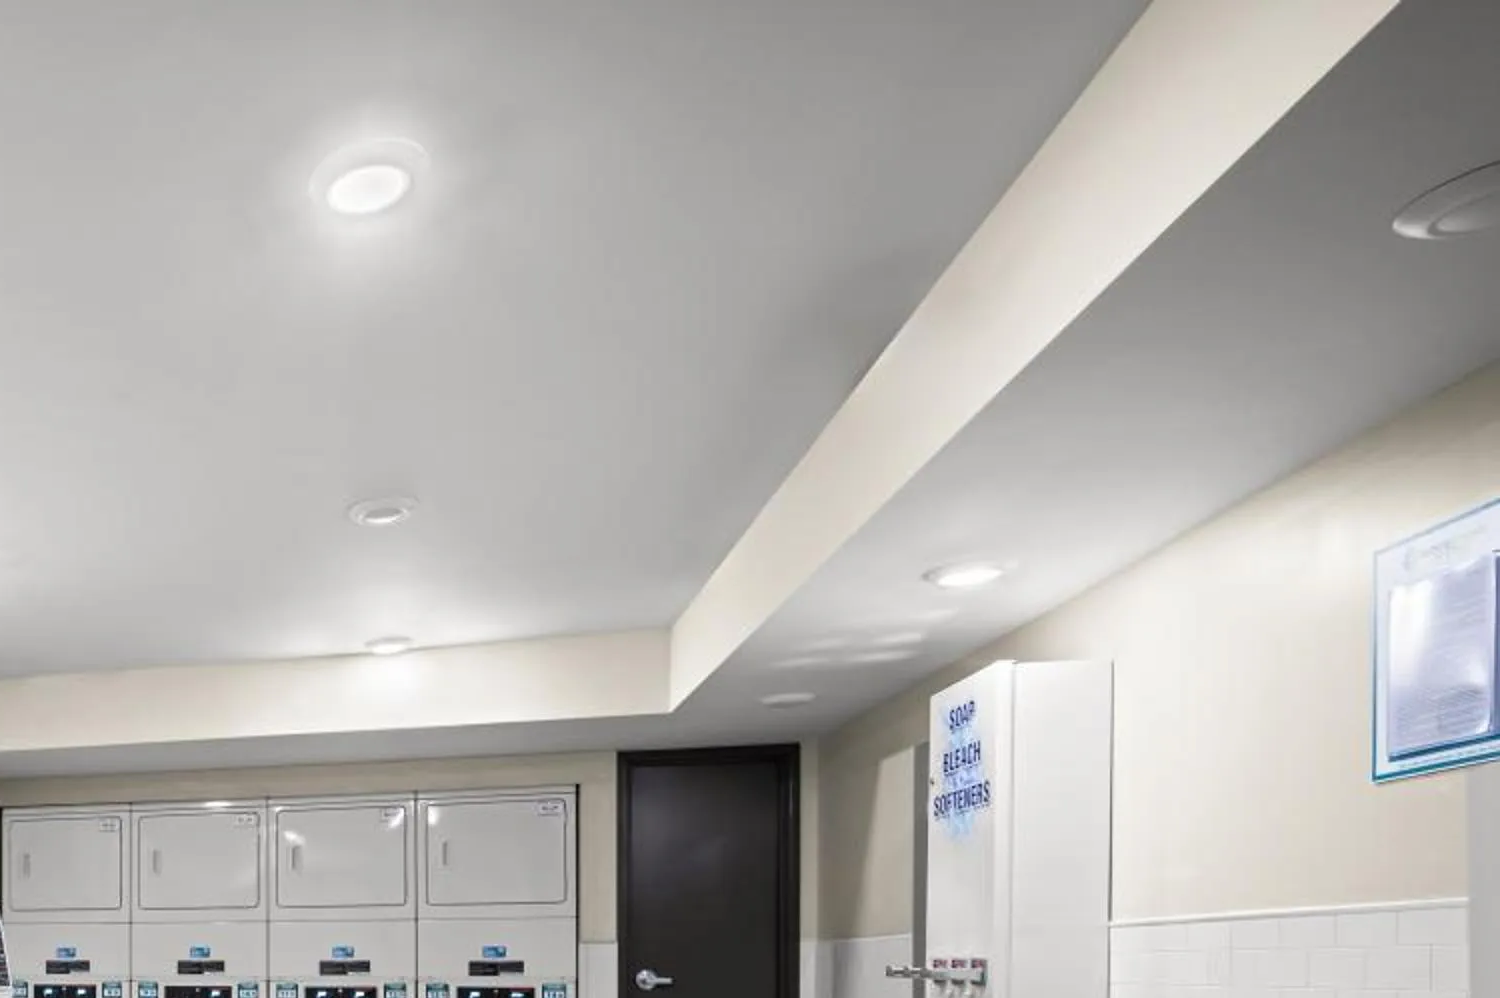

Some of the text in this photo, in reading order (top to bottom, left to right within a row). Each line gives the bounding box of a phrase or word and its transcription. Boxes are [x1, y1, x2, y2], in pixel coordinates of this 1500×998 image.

[949, 700, 975, 732] SOAP
[943, 740, 981, 773] BLEACH
[933, 780, 990, 818] SOFTENERS
